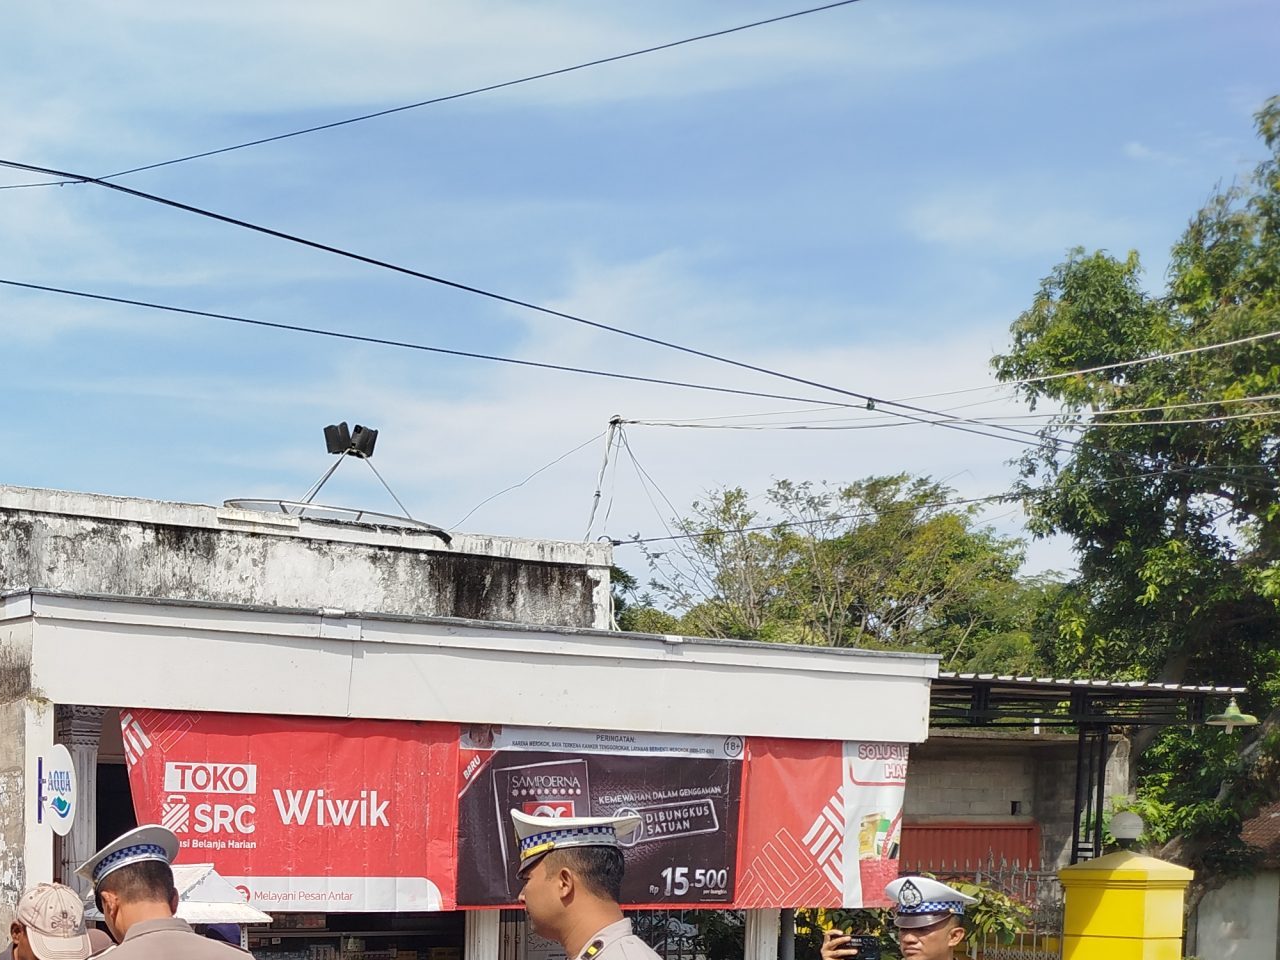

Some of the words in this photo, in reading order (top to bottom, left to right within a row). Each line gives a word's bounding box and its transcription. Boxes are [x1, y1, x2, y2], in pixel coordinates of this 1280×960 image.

[725, 741, 741, 751] 18+
[858, 744, 903, 760] SOLUSI
[462, 753, 482, 780] BARU
[47, 770, 72, 796] AQUA
[174, 764, 248, 792] TOKO
[511, 775, 581, 788] SAMPOERNA
[598, 793, 652, 804] KEMEWAHAN
[652, 790, 679, 799] DALAM
[272, 789, 391, 827] Wiwik
[645, 805, 710, 824] DIBUNGKUS
[194, 803, 257, 834] SRC
[646, 819, 691, 835] SATUAN
[192, 839, 226, 851] Belanja
[227, 840, 257, 849] Harian
[254, 890, 297, 903] Melayani
[298, 891, 326, 901] Pesan
[327, 891, 353, 901] Antar
[649, 884, 660, 896] Rp
